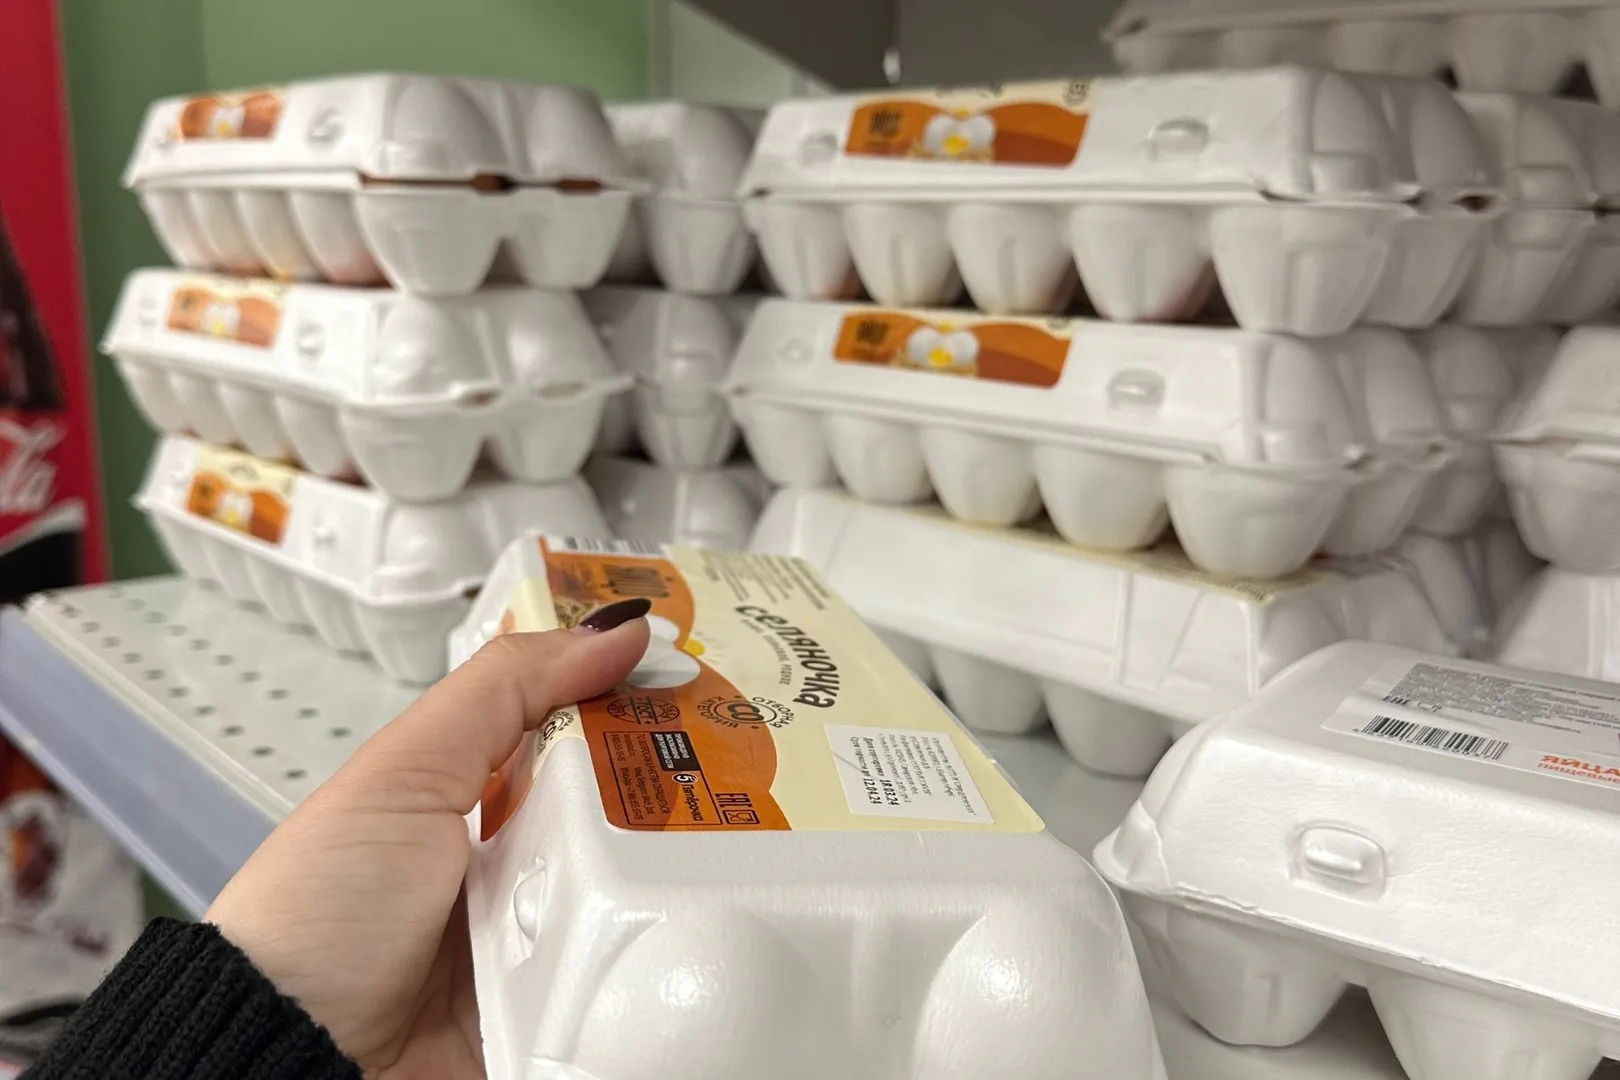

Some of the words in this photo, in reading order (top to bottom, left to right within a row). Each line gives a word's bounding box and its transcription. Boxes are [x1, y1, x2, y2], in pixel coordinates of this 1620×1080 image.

[697, 695, 739, 729] КАТЕГОРИЯ
[752, 696, 795, 729] ОТБОРНАЯ
[682, 784, 703, 820] Пятёрочка
[863, 778, 883, 805] 12.04.24
[879, 779, 900, 805] 18.03.24
